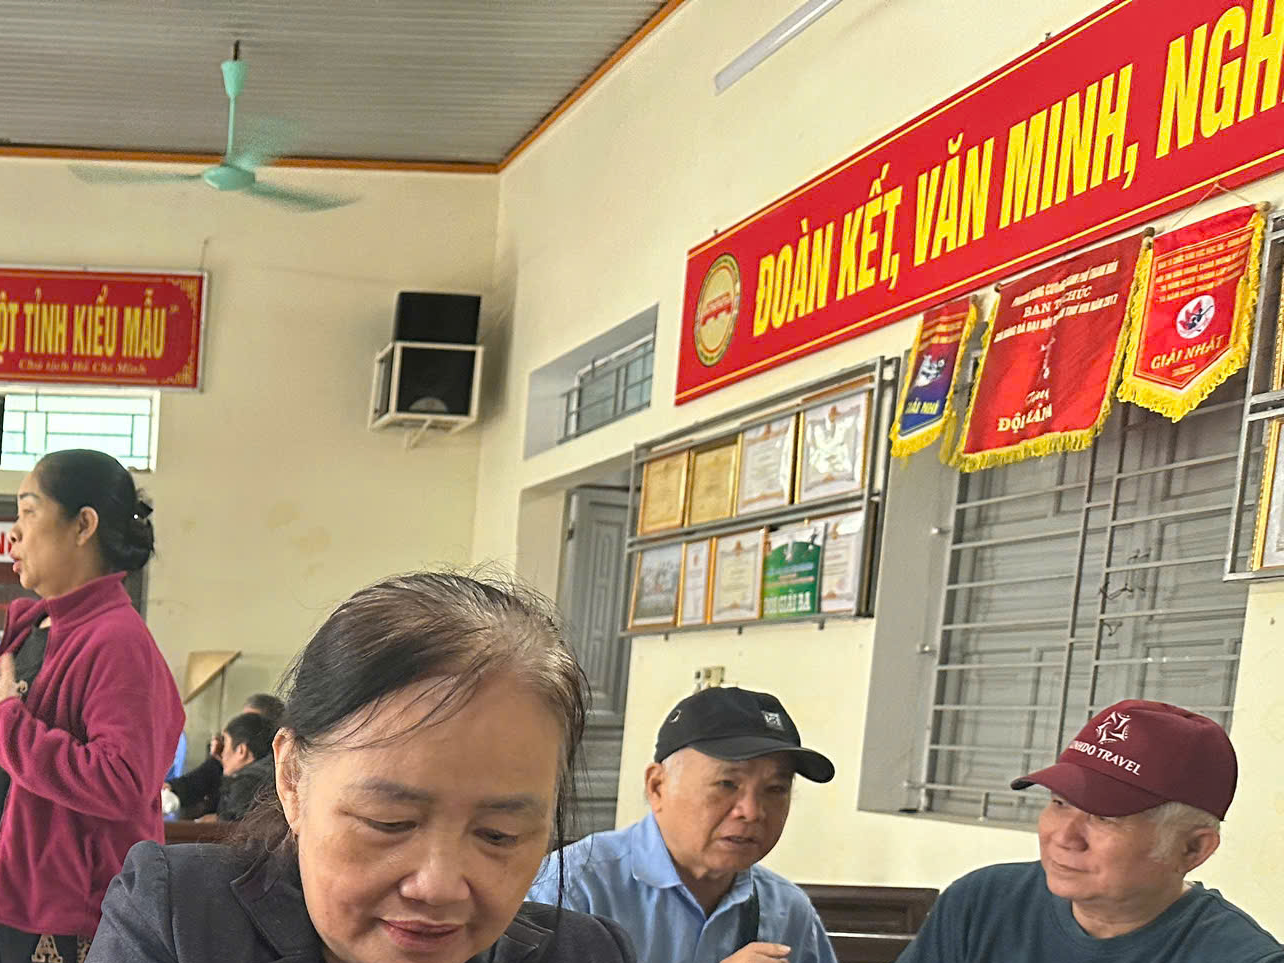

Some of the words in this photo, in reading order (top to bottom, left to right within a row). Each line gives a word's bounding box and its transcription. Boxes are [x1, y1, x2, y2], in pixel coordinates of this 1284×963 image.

[752, 220, 833, 337] ĐOÀN
[836, 162, 903, 301] KẾT,
[913, 131, 995, 264] VĂN
[999, 63, 1138, 230] MINH,
[1156, 0, 1284, 158] NGH
[23, 287, 67, 354] TỈNH
[72, 285, 118, 357] KIỂU
[122, 288, 166, 358] MẪU
[1023, 302, 1052, 318] BAN
[1150, 348, 1181, 370] GIẢI
[1097, 748, 1141, 776] TRAVEL
